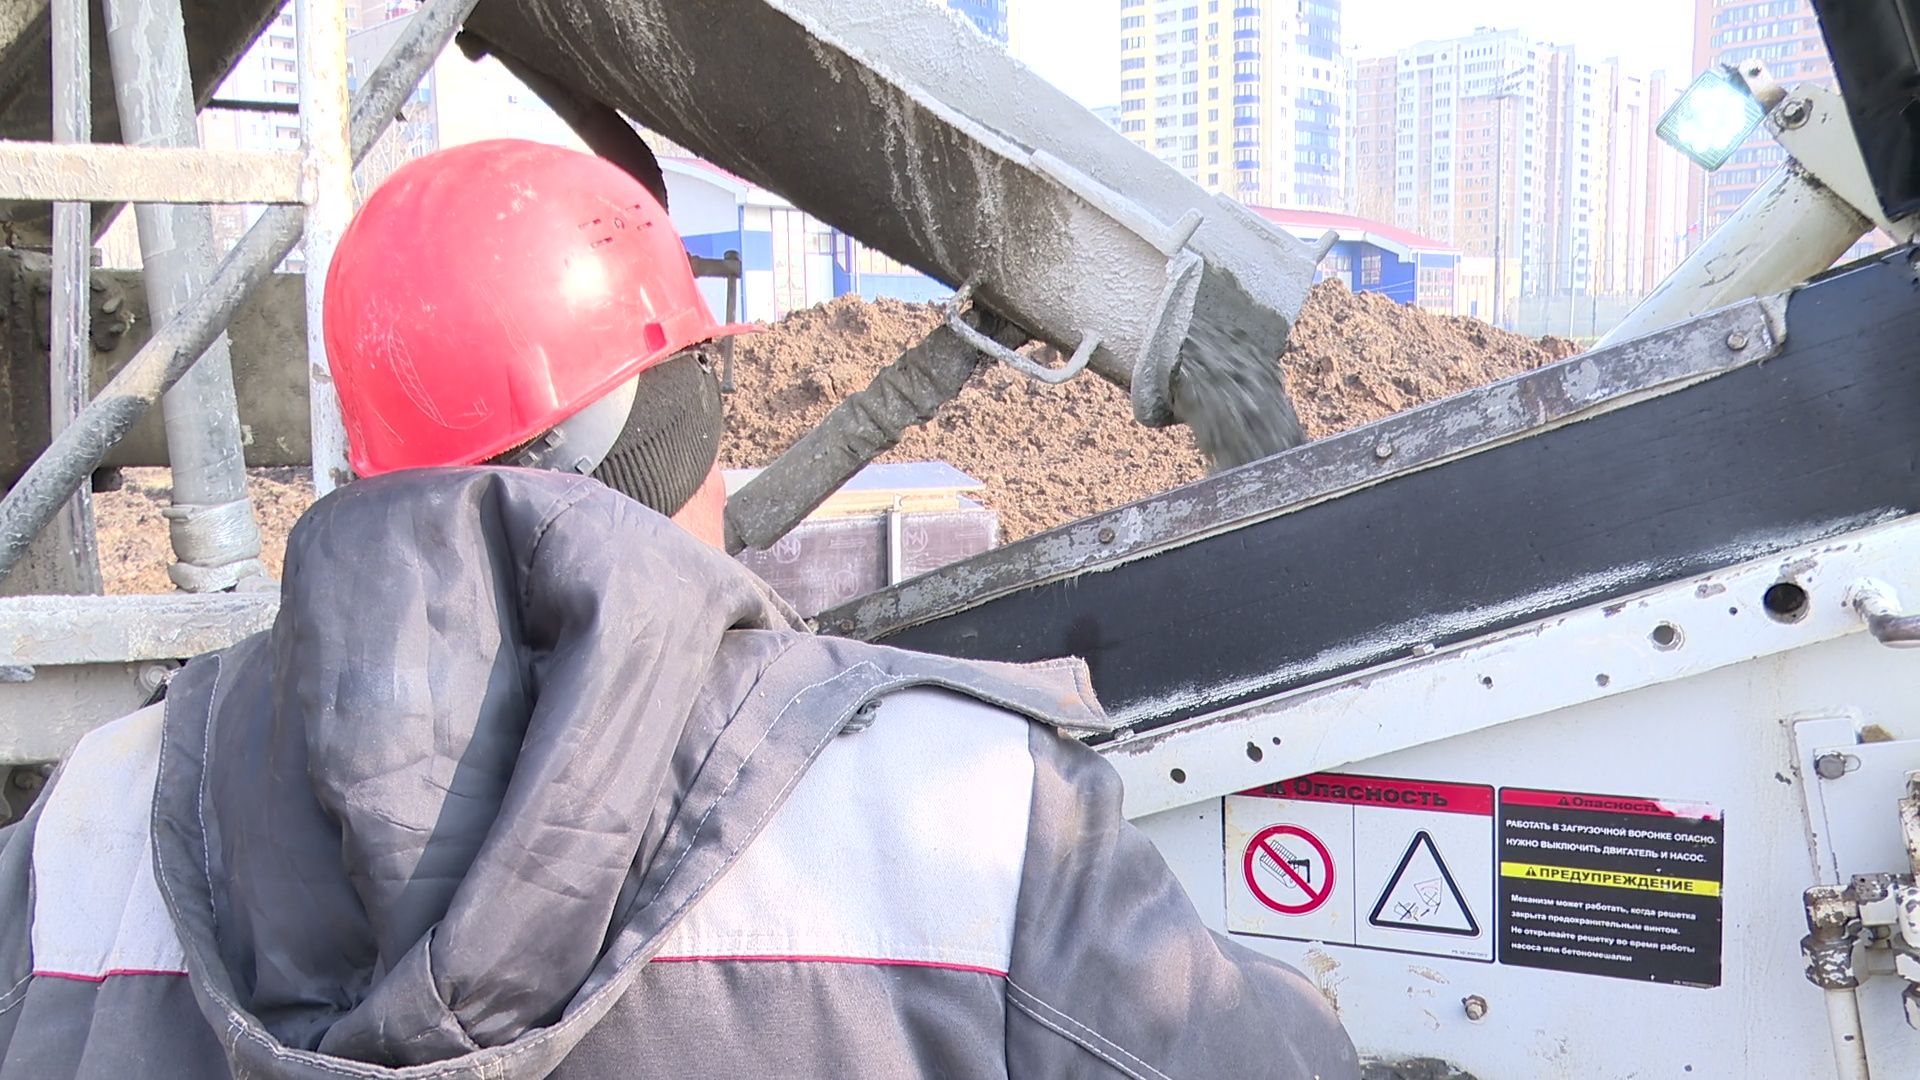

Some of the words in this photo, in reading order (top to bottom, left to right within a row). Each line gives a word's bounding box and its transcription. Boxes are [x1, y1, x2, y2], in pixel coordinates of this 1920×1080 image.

[1293, 779, 1448, 806] Опасность
[1573, 797, 1660, 812] Опасность
[1506, 820, 1550, 830] РАБОТАТЬ
[1552, 823, 1560, 831] В
[1561, 824, 1626, 837] ЗАГРУЗОЧНОЙ
[1628, 829, 1672, 840] ВОРОНКЕ
[1674, 833, 1717, 844] ОПАСНО.
[1506, 838, 1539, 848] НУЖНО
[1541, 840, 1601, 853] ВЫКЛЮЧИТЬ
[1602, 846, 1659, 858] ДВИГАТЕЛЬ
[1660, 851, 1668, 859] И
[1670, 852, 1707, 862] НАСОС.
[1539, 867, 1694, 892] ПРЕДУПРЕЖДЕНИЕ
[1511, 894, 1554, 905] Механизм
[1556, 900, 1583, 908] может
[1585, 903, 1629, 914] работать,
[1631, 907, 1655, 916] когда
[1657, 910, 1696, 920] решетка
[1511, 911, 1546, 920] закрыта
[1548, 914, 1642, 930] предохранительным
[1644, 925, 1681, 934] винтом.
[1511, 926, 1522, 934] Не
[1524, 929, 1575, 940] открывайте
[1577, 934, 1614, 946] решетку
[1629, 940, 1658, 949] время
[1660, 943, 1696, 953] работы
[1511, 942, 1541, 951] насоса
[1561, 947, 1632, 962] бетономешалки
